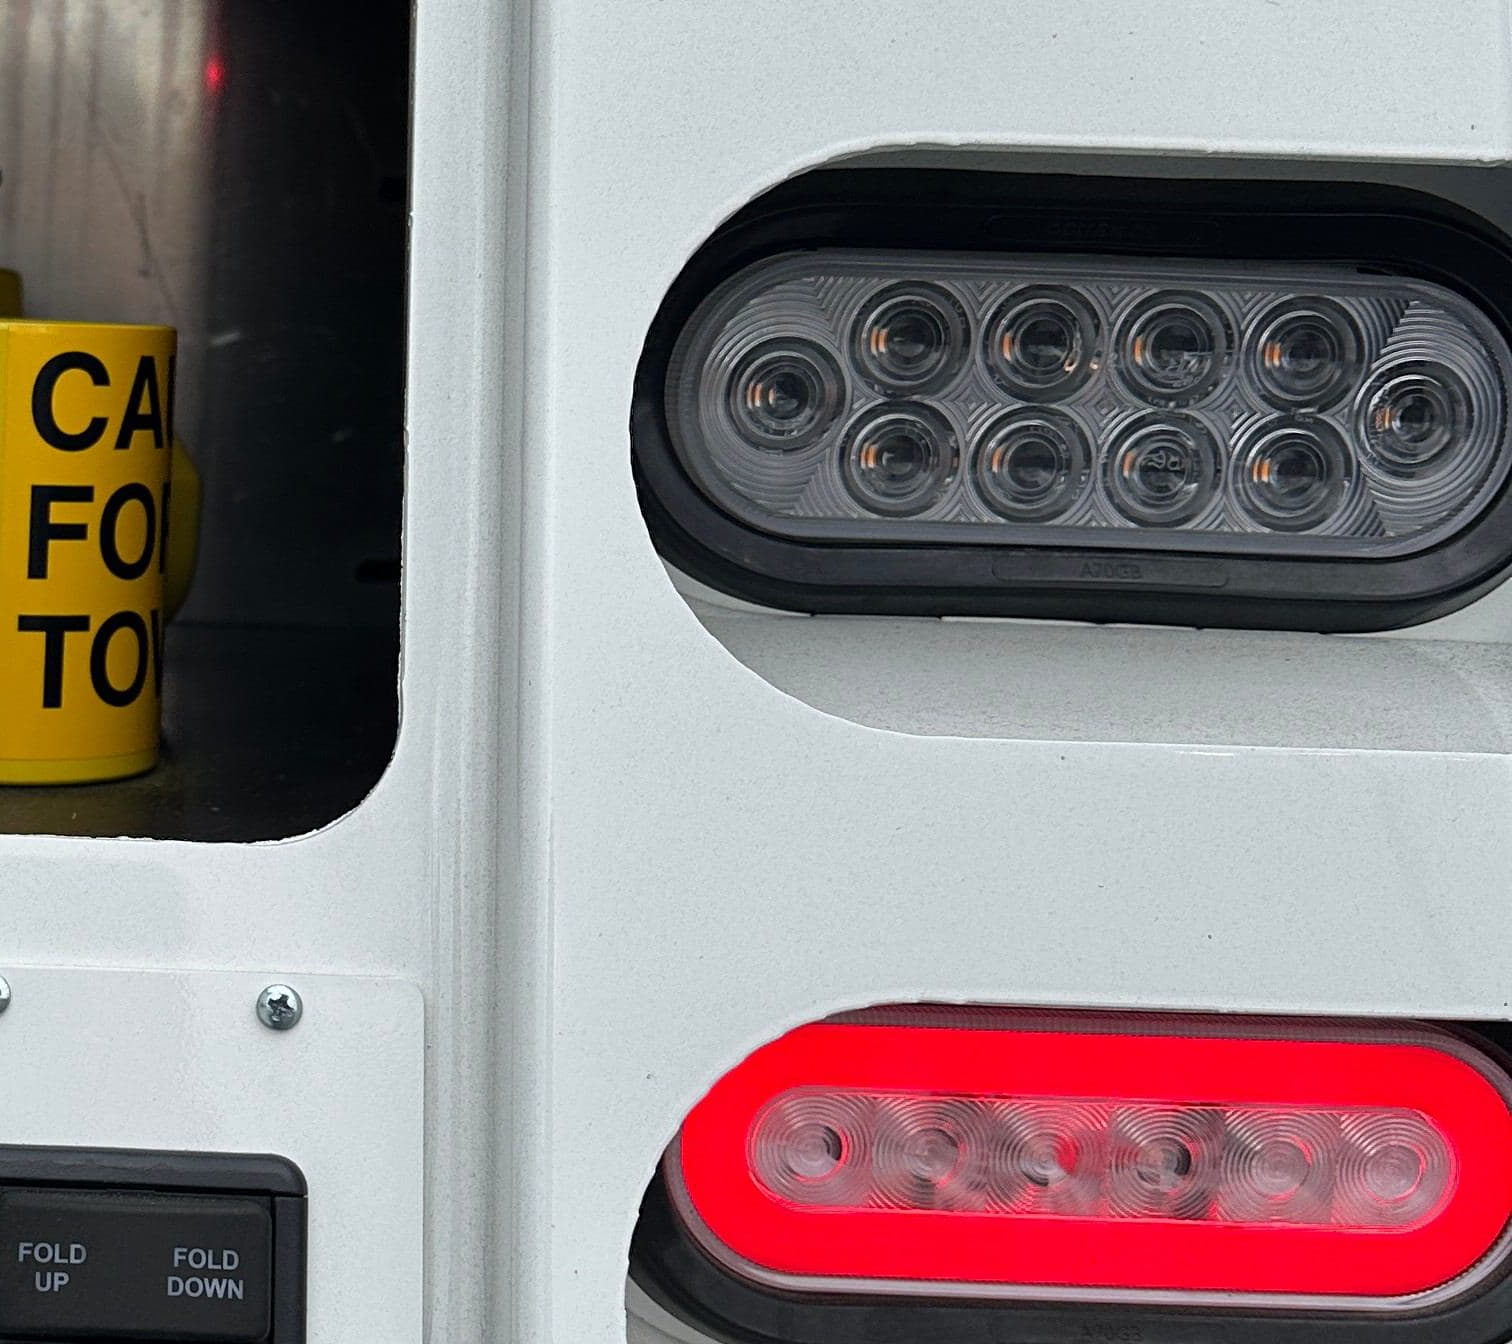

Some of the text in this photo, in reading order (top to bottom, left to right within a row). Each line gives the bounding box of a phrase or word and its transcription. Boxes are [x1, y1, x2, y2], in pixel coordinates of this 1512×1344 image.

[31, 350, 175, 452] CA
[26, 482, 171, 580] FO
[18, 1242, 87, 1264] FOLD
[173, 1247, 239, 1270] FOLD
[35, 1271, 70, 1292] UP
[167, 1276, 243, 1300] DOWN
